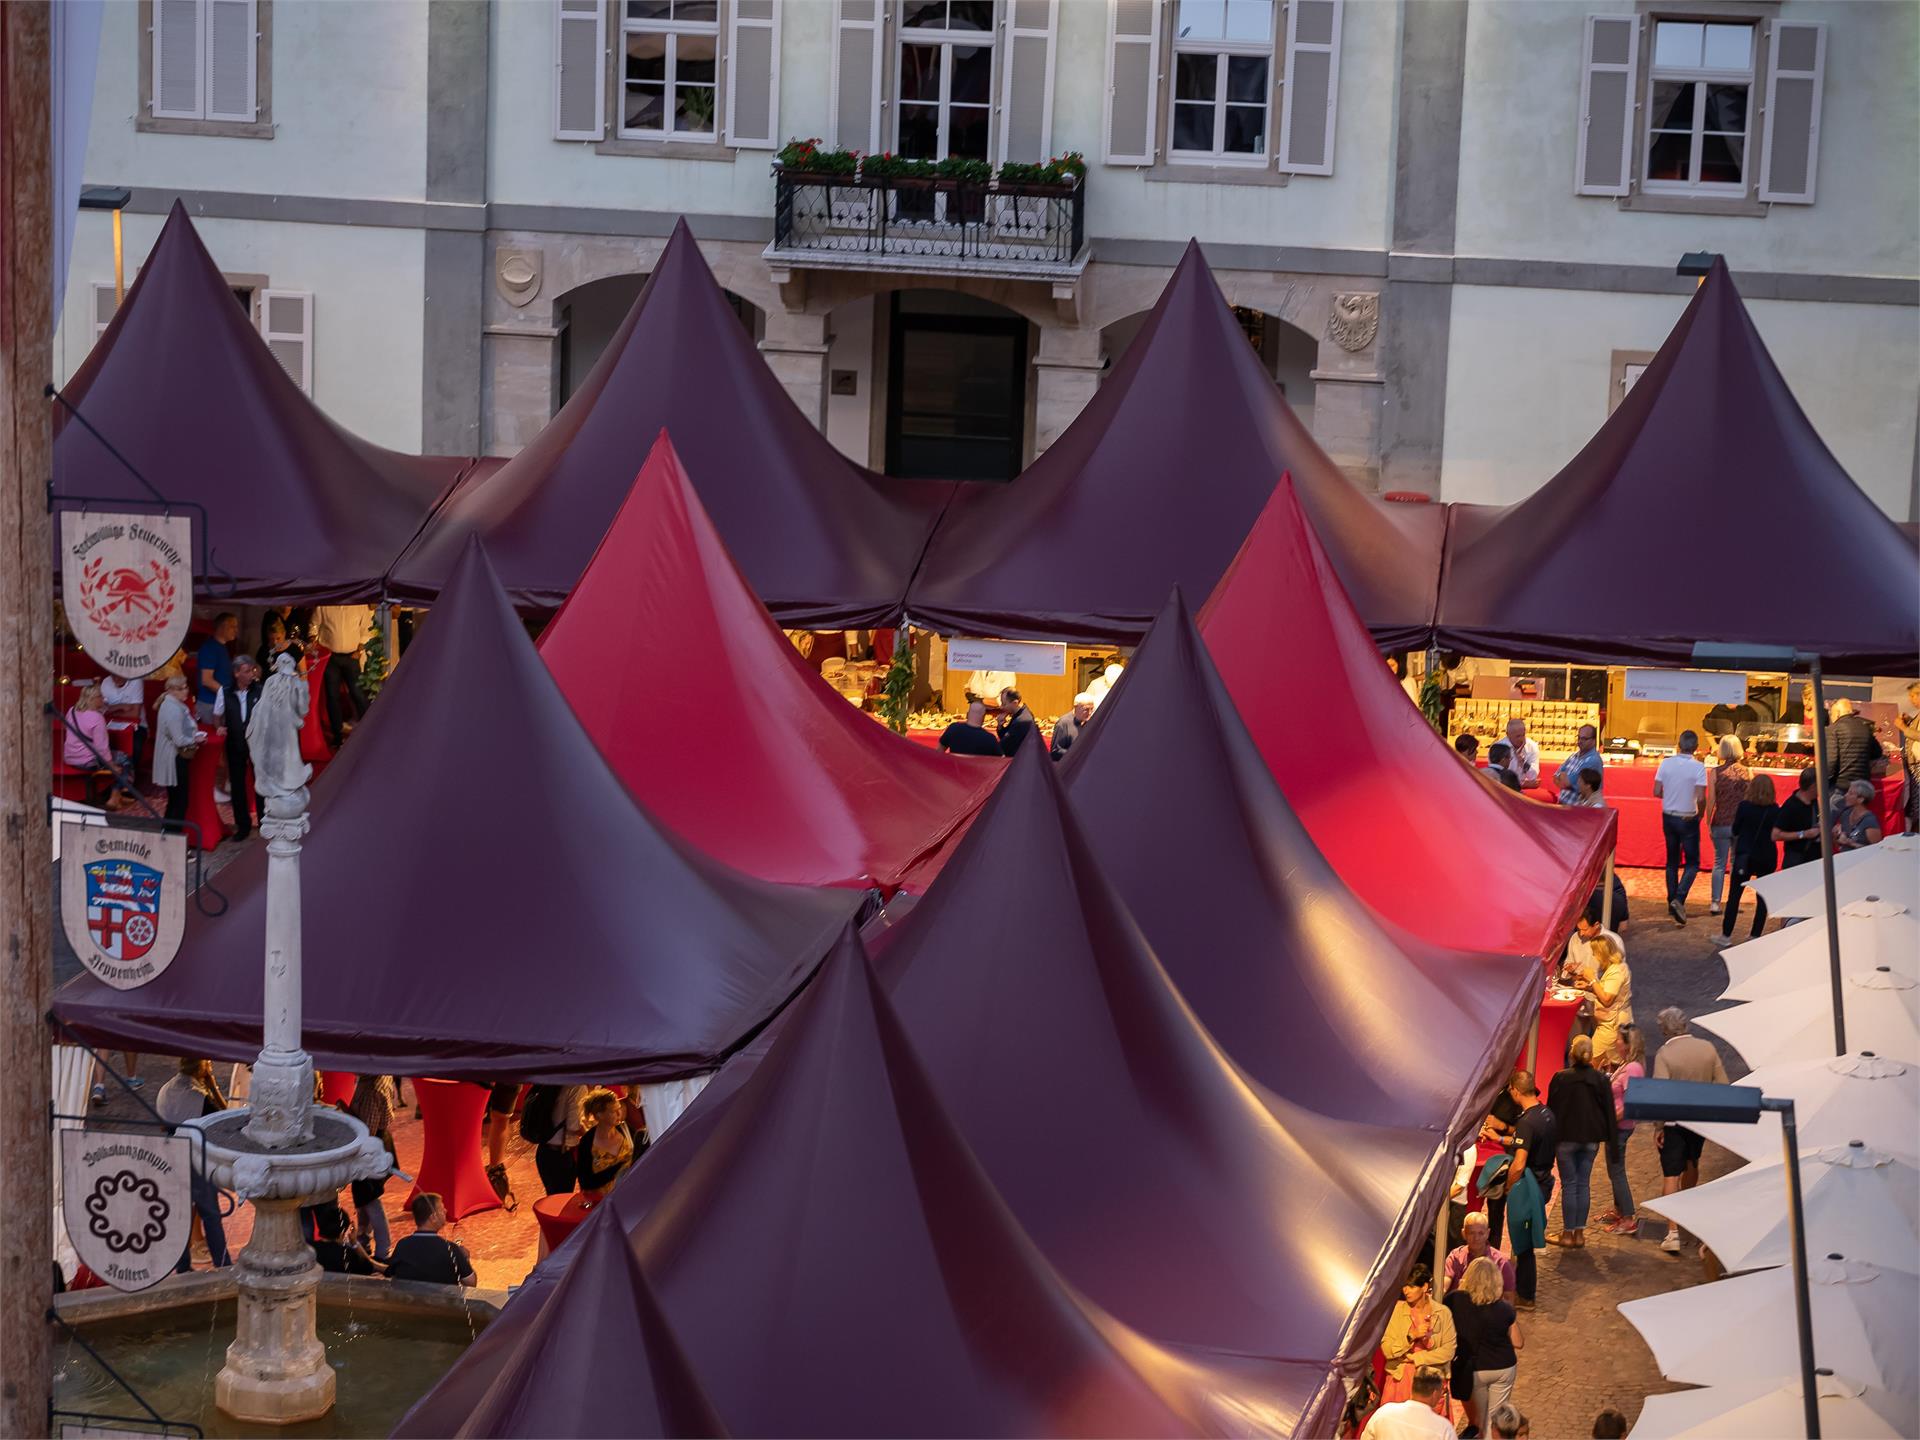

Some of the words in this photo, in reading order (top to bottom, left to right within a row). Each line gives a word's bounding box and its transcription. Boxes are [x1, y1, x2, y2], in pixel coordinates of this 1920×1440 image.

[128, 523, 182, 566] Feuerwehr
[95, 839, 152, 859] Gemeinde
[88, 954, 155, 980] Heppenheim
